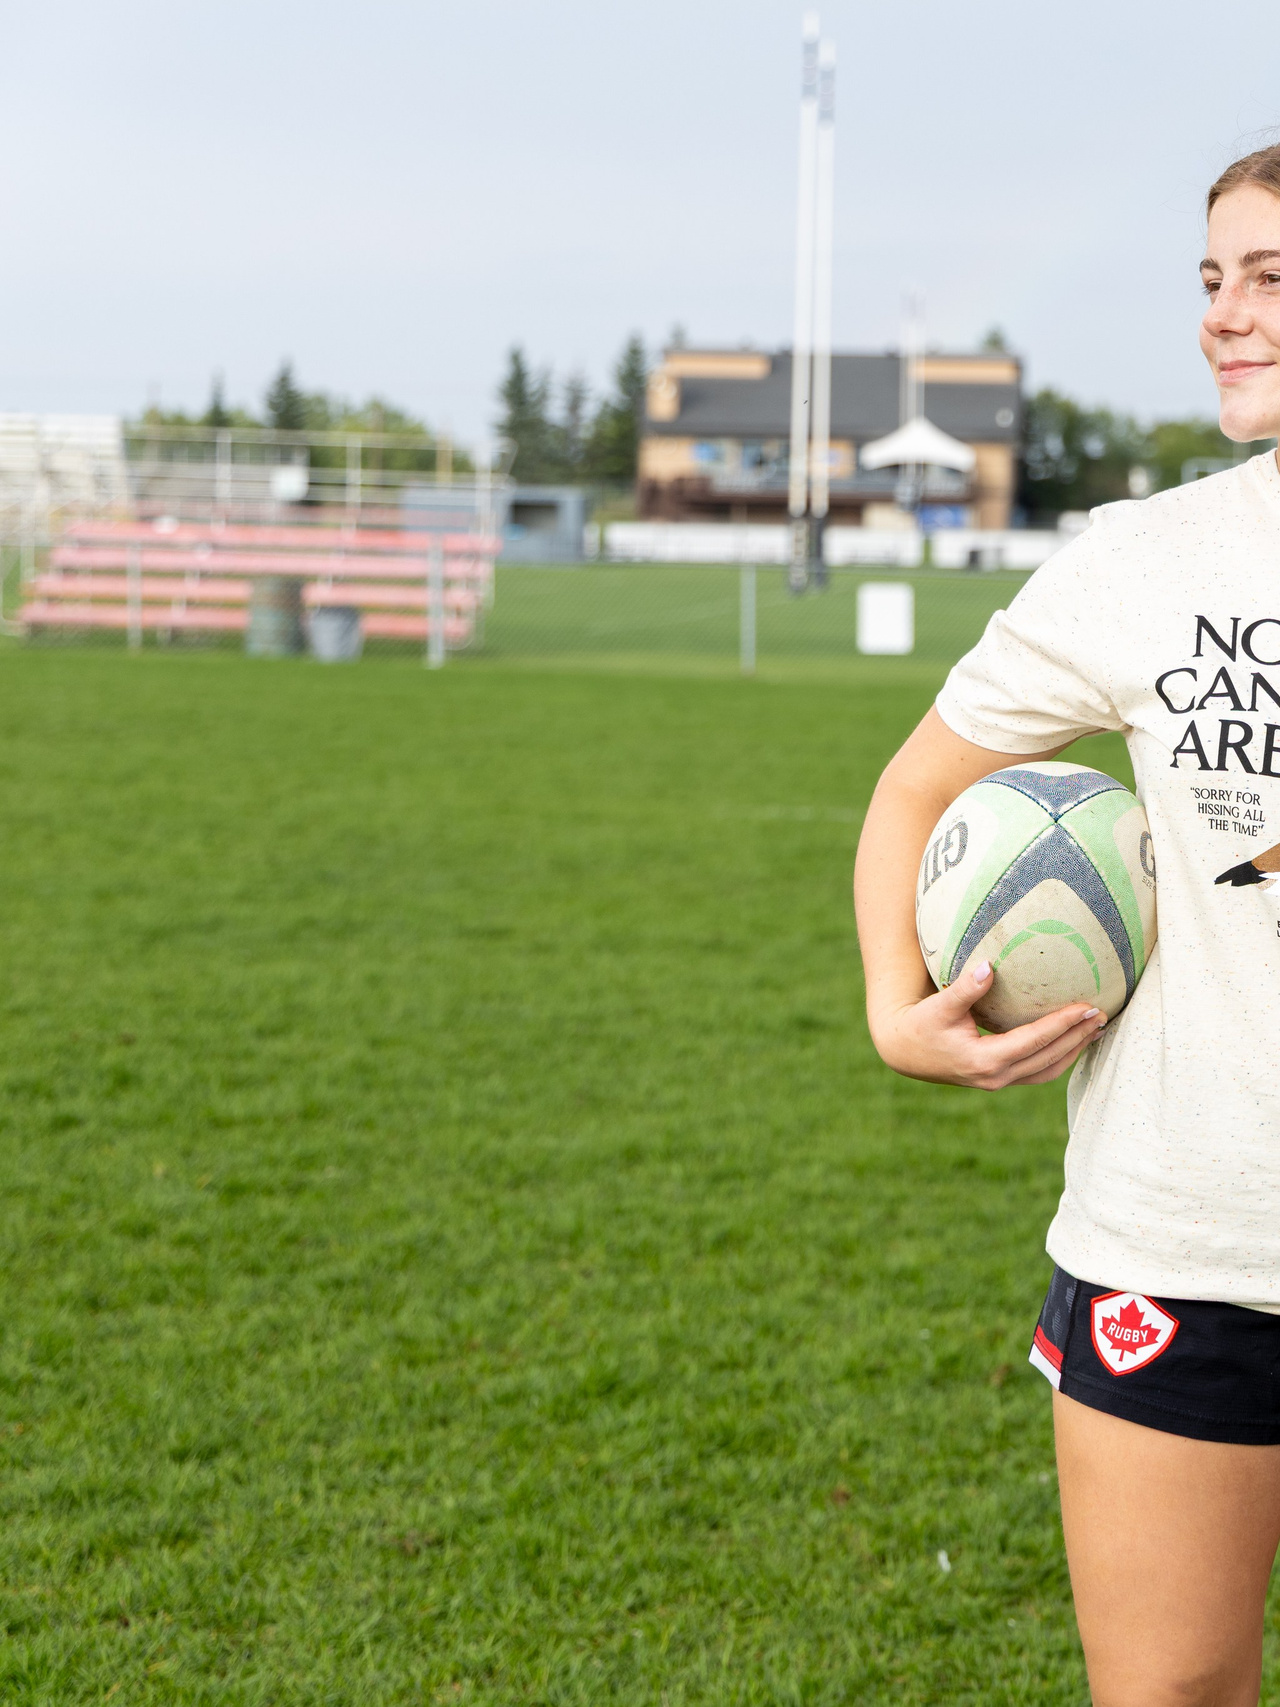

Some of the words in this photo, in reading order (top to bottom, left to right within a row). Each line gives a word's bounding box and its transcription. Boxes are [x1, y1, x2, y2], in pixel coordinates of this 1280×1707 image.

[1236, 791, 1261, 806] FOR
[1197, 802, 1240, 819] HISSING
[1243, 808, 1266, 823] ALL
[1208, 818, 1229, 831] THE
[1106, 1321, 1149, 1343] RUGBY
